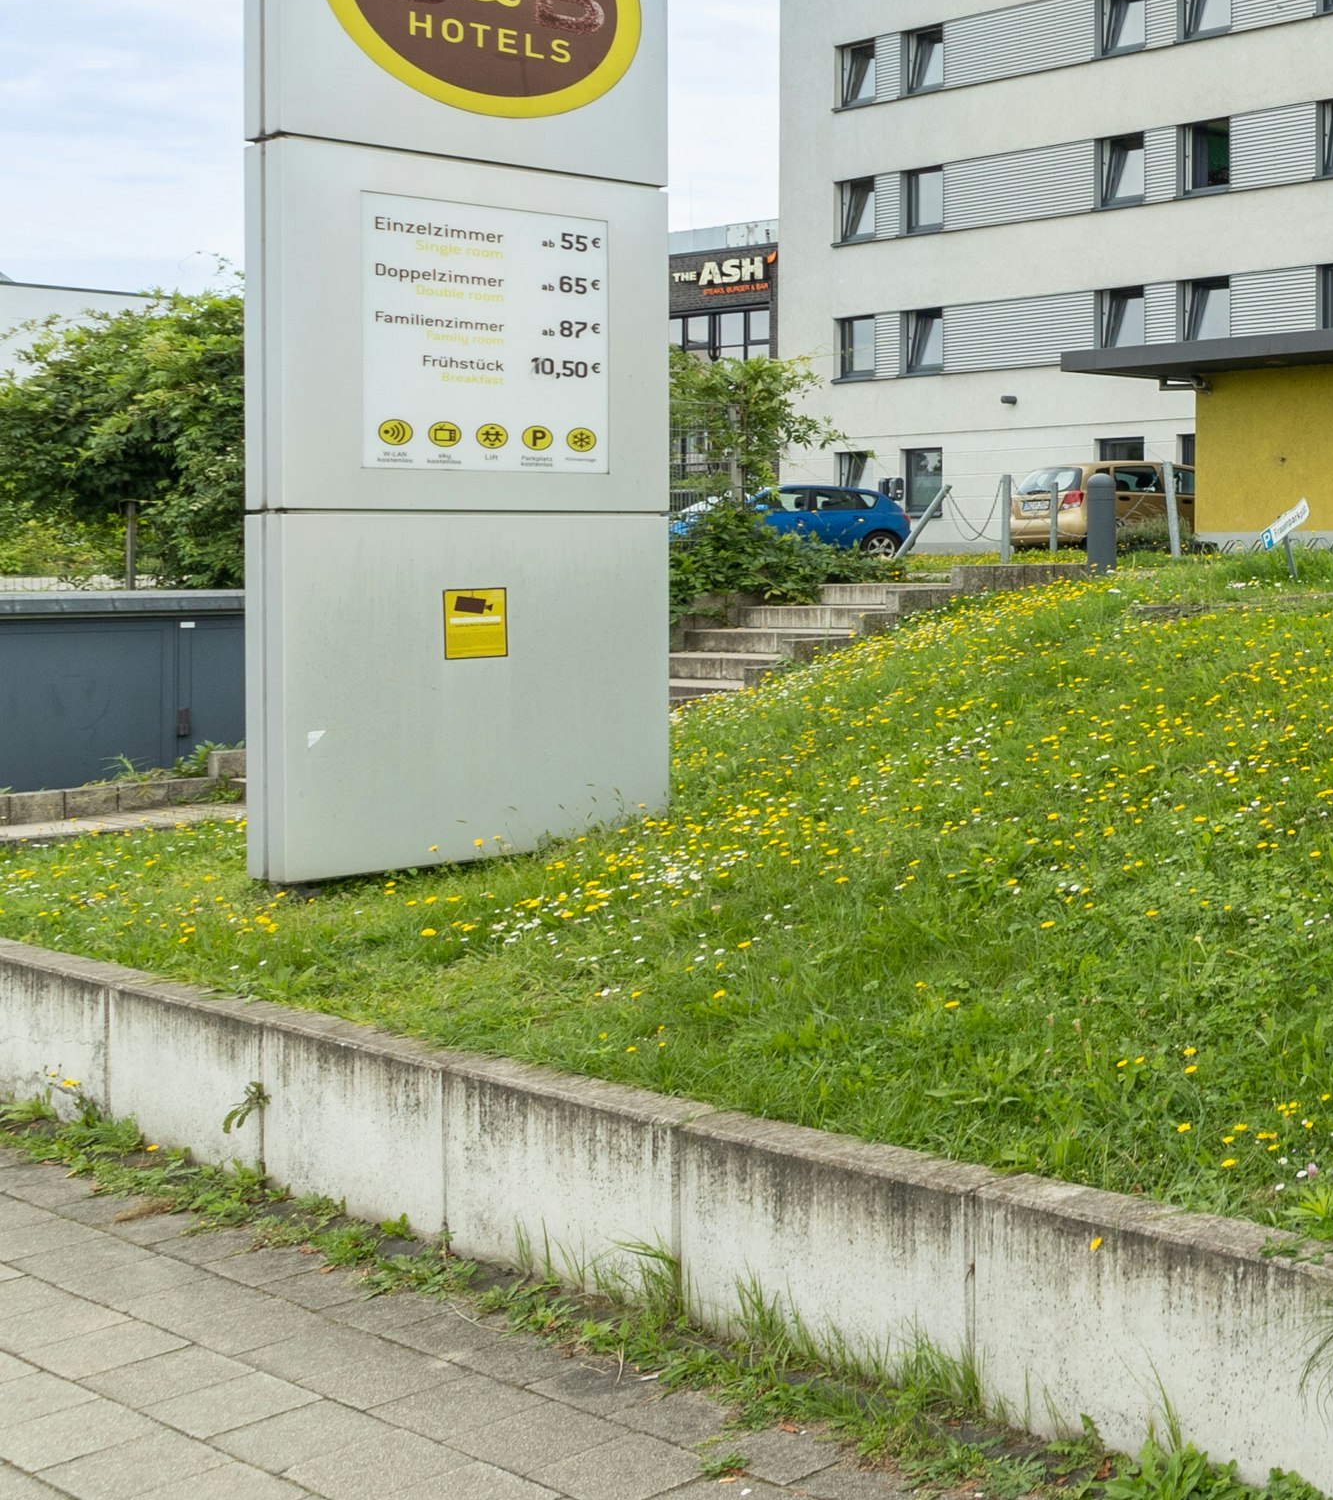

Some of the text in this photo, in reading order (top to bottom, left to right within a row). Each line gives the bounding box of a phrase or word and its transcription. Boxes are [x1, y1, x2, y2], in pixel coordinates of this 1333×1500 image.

[409, 11, 571, 63] HOTELS
[375, 216, 503, 243] Einzelzimmer
[542, 240, 555, 248] ab
[416, 240, 503, 259] Single room
[375, 263, 504, 287] Doppelzimmer
[542, 284, 555, 292] ab
[672, 256, 763, 285] THE ASH
[416, 285, 504, 302] Double room
[375, 311, 504, 332] Familienzimmer
[542, 328, 555, 337] ab
[426, 331, 504, 346] Family room
[423, 355, 504, 372] Frühstück
[442, 372, 504, 386] Breakfast
